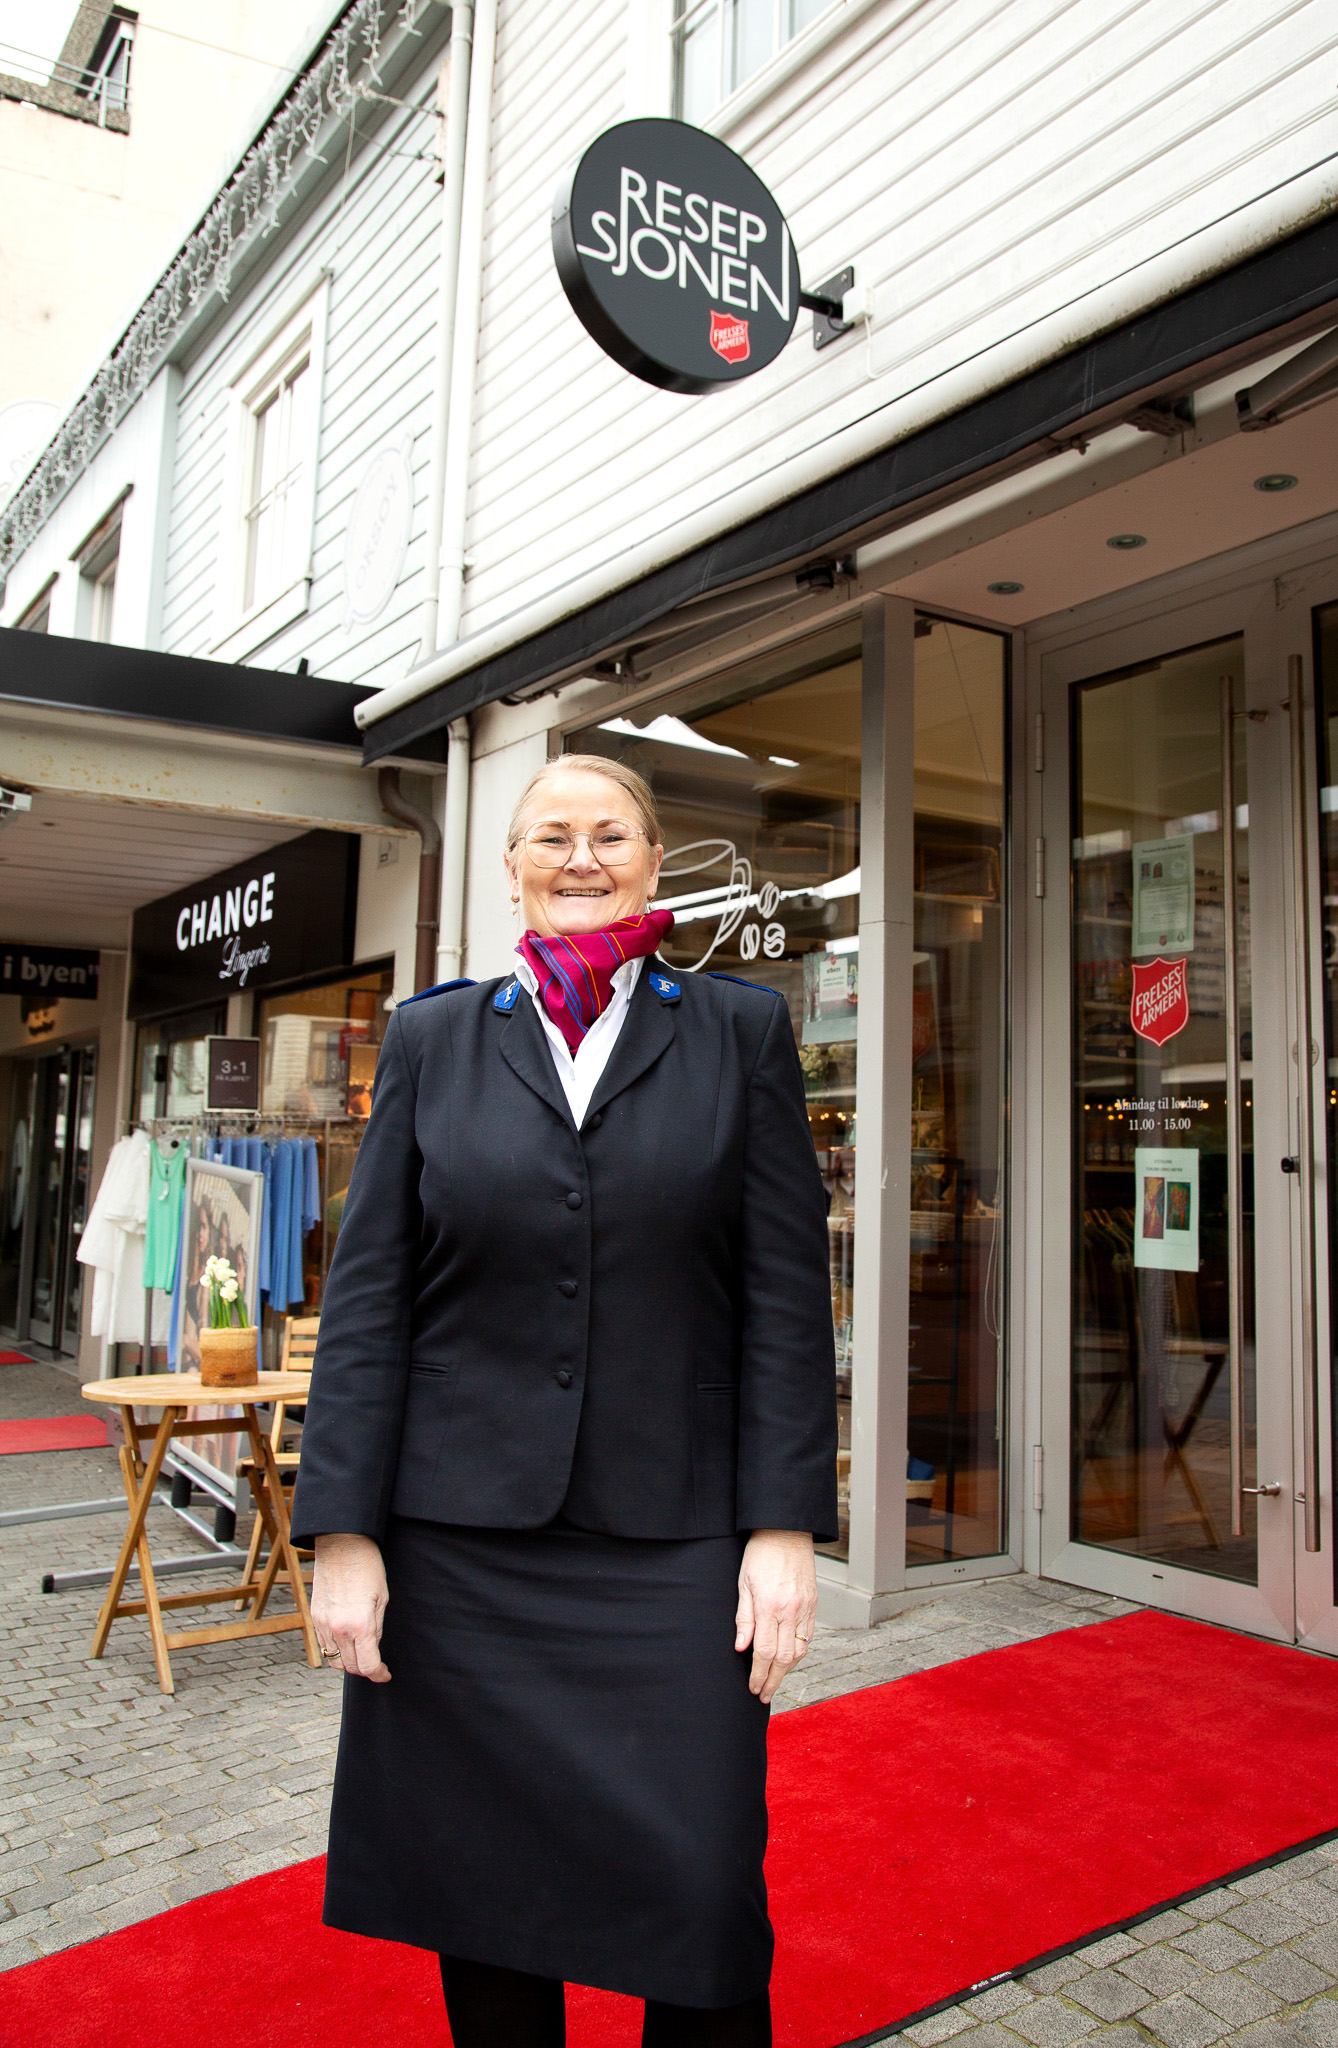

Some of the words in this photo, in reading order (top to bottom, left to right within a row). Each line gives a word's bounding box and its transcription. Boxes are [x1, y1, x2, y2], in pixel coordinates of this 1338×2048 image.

[620, 166, 768, 260] RESEP
[576, 210, 790, 322] SJONEN
[176, 871, 275, 951] CHANGE
[4, 955, 13, 979] i
[219, 935, 271, 987] Lingerie
[658, 978, 675, 993] F
[1140, 984, 1182, 1031] ARMEEN
[1115, 1097, 1156, 1112] Mandag
[1158, 1096, 1169, 1110] til
[1129, 1118, 1155, 1131] 11.00
[1164, 1117, 1192, 1130] 15.00
